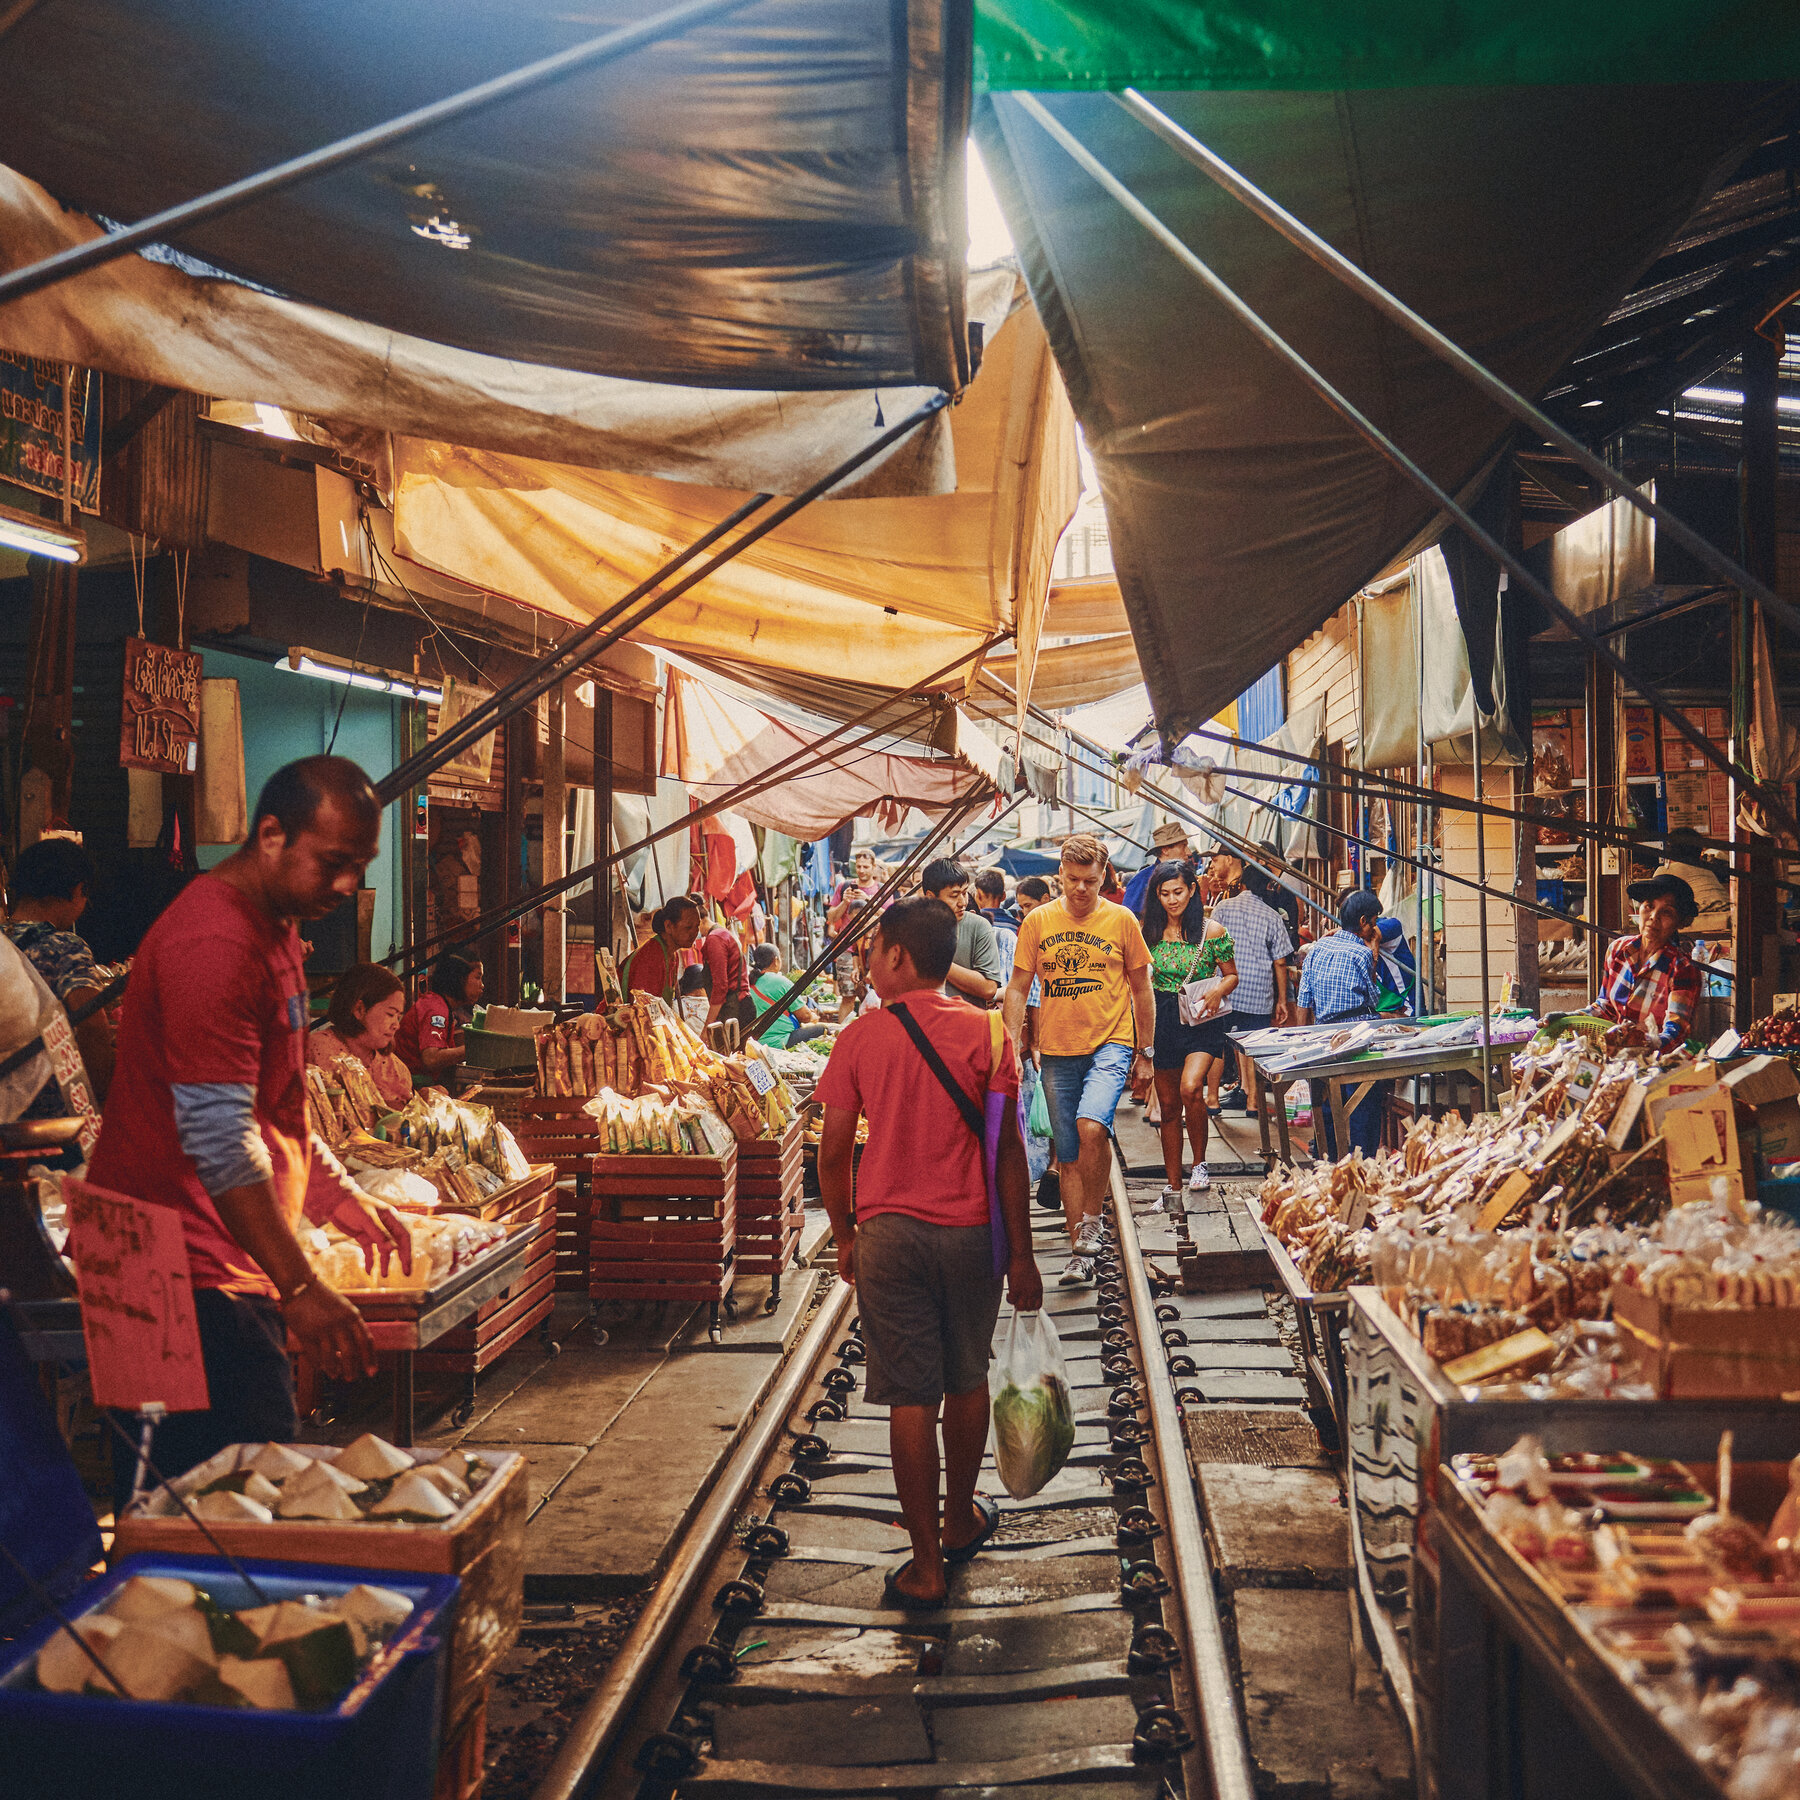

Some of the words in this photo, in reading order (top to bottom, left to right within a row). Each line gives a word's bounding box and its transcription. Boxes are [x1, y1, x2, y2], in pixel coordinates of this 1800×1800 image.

[162, 718, 187, 774] Shop
[1039, 931, 1112, 955] YOKOSUKA
[1044, 979, 1104, 1001] Kanagawa
